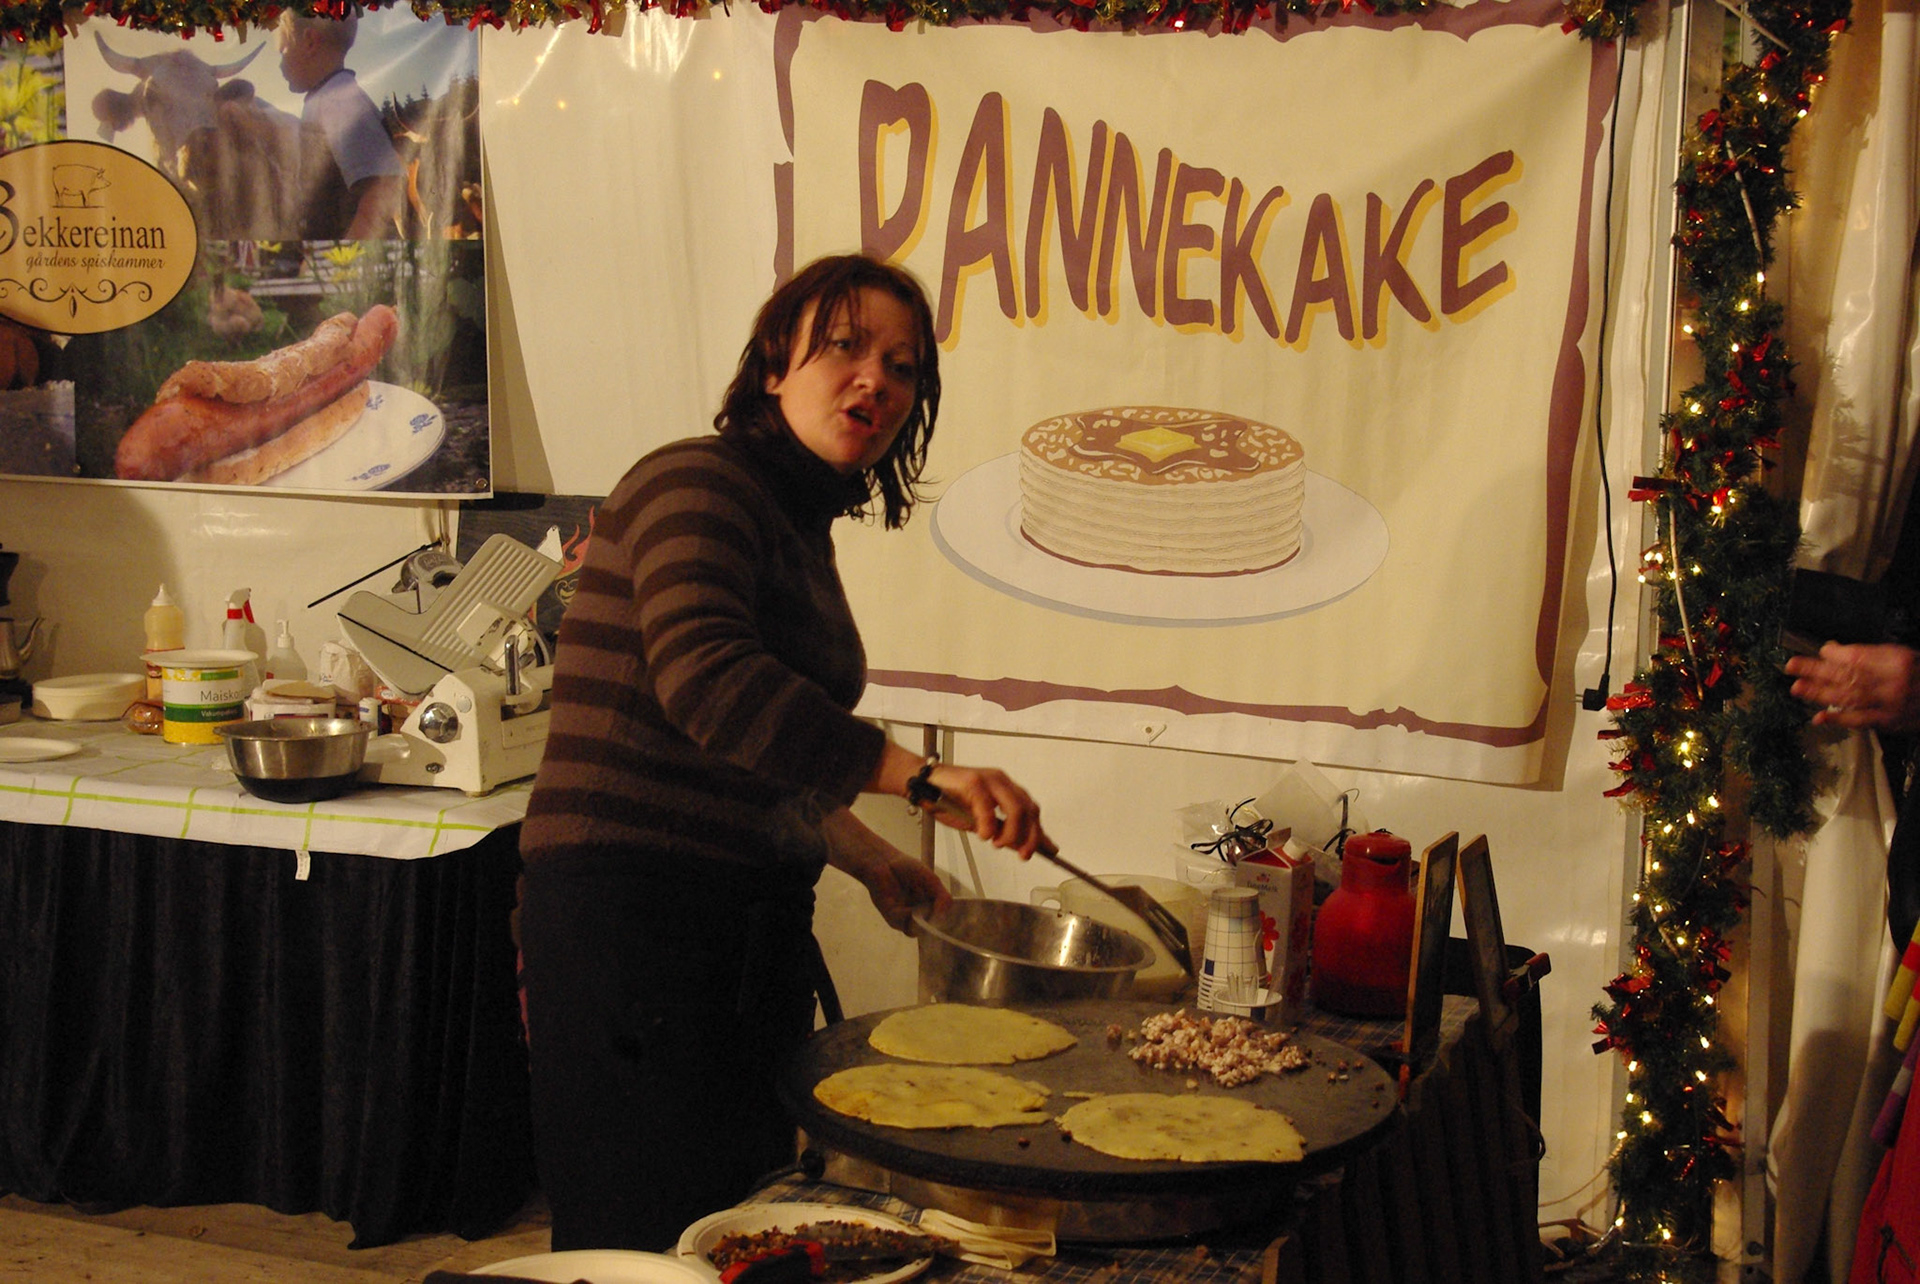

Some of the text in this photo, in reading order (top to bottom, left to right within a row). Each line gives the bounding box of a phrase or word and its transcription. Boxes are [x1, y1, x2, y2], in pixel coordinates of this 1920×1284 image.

[26, 250, 165, 274] gårdens spiskammer
[859, 79, 1523, 350] PANNEKAKE
